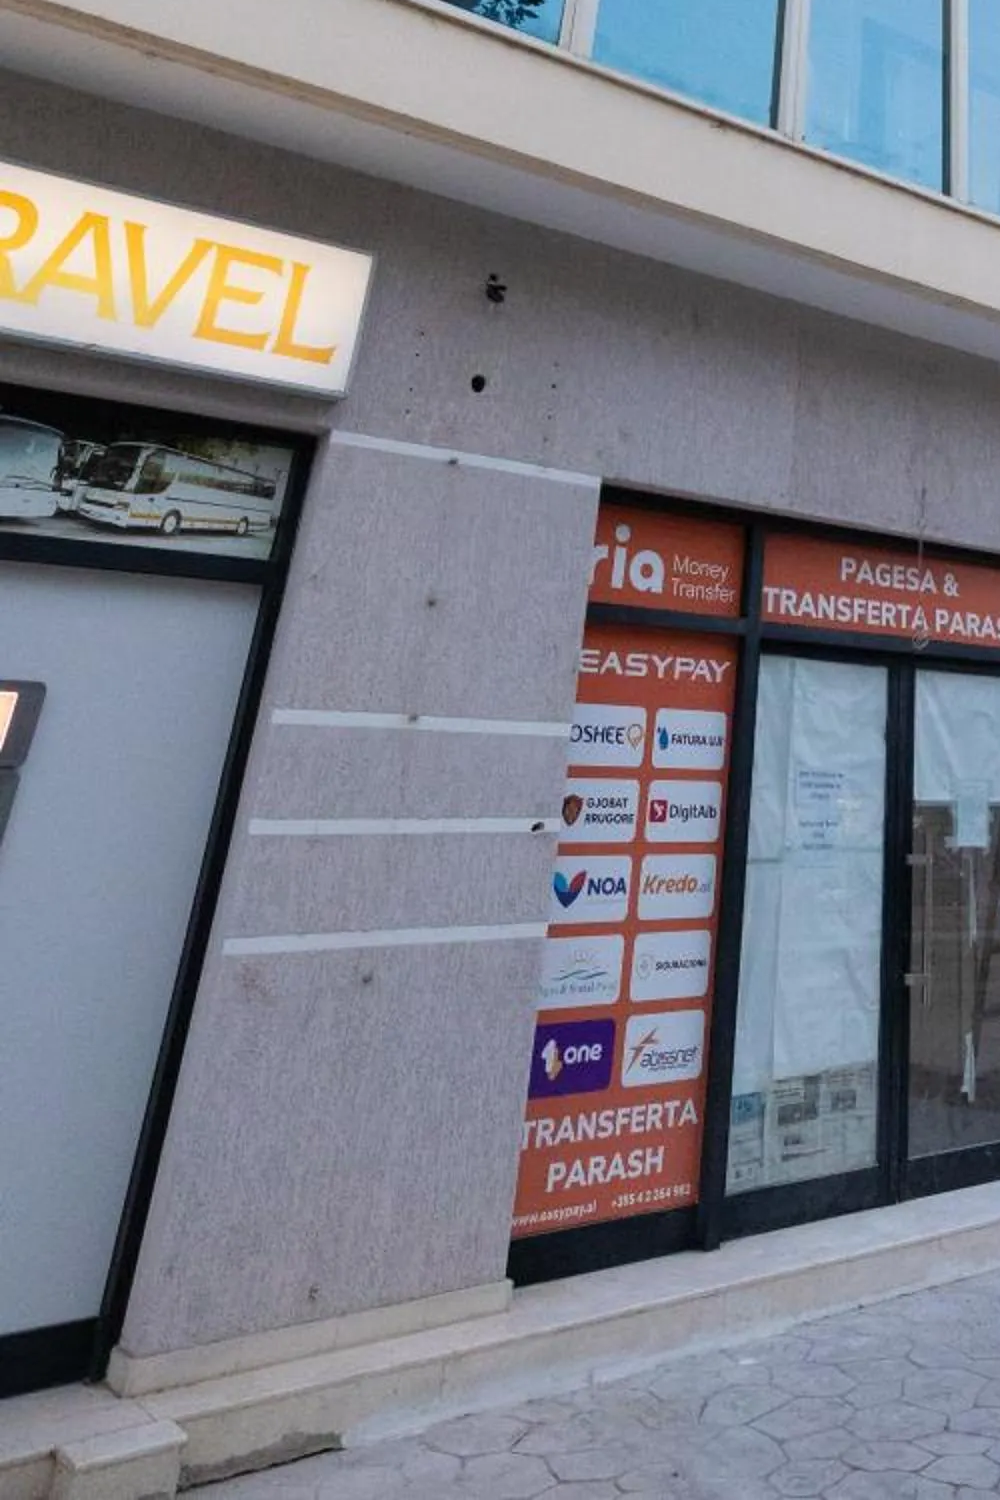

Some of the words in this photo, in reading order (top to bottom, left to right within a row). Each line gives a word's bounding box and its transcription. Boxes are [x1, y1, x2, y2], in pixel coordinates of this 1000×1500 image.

[672, 554, 730, 583] Money
[840, 556, 937, 594] PAGESA
[943, 572, 960, 597] &
[671, 577, 737, 603] Transfer
[763, 586, 928, 631] TRANSFERTA
[578, 649, 732, 684] EASYPAY
[569, 724, 625, 744] OSHEE
[671, 734, 706, 746] FATURA
[586, 797, 630, 809] GJOBAT
[669, 805, 717, 822] DigitAlb
[587, 876, 628, 897] NOA
[563, 1043, 603, 1065] one
[521, 1099, 698, 1151] TRANSFERTA
[545, 1146, 665, 1193] PARASH
